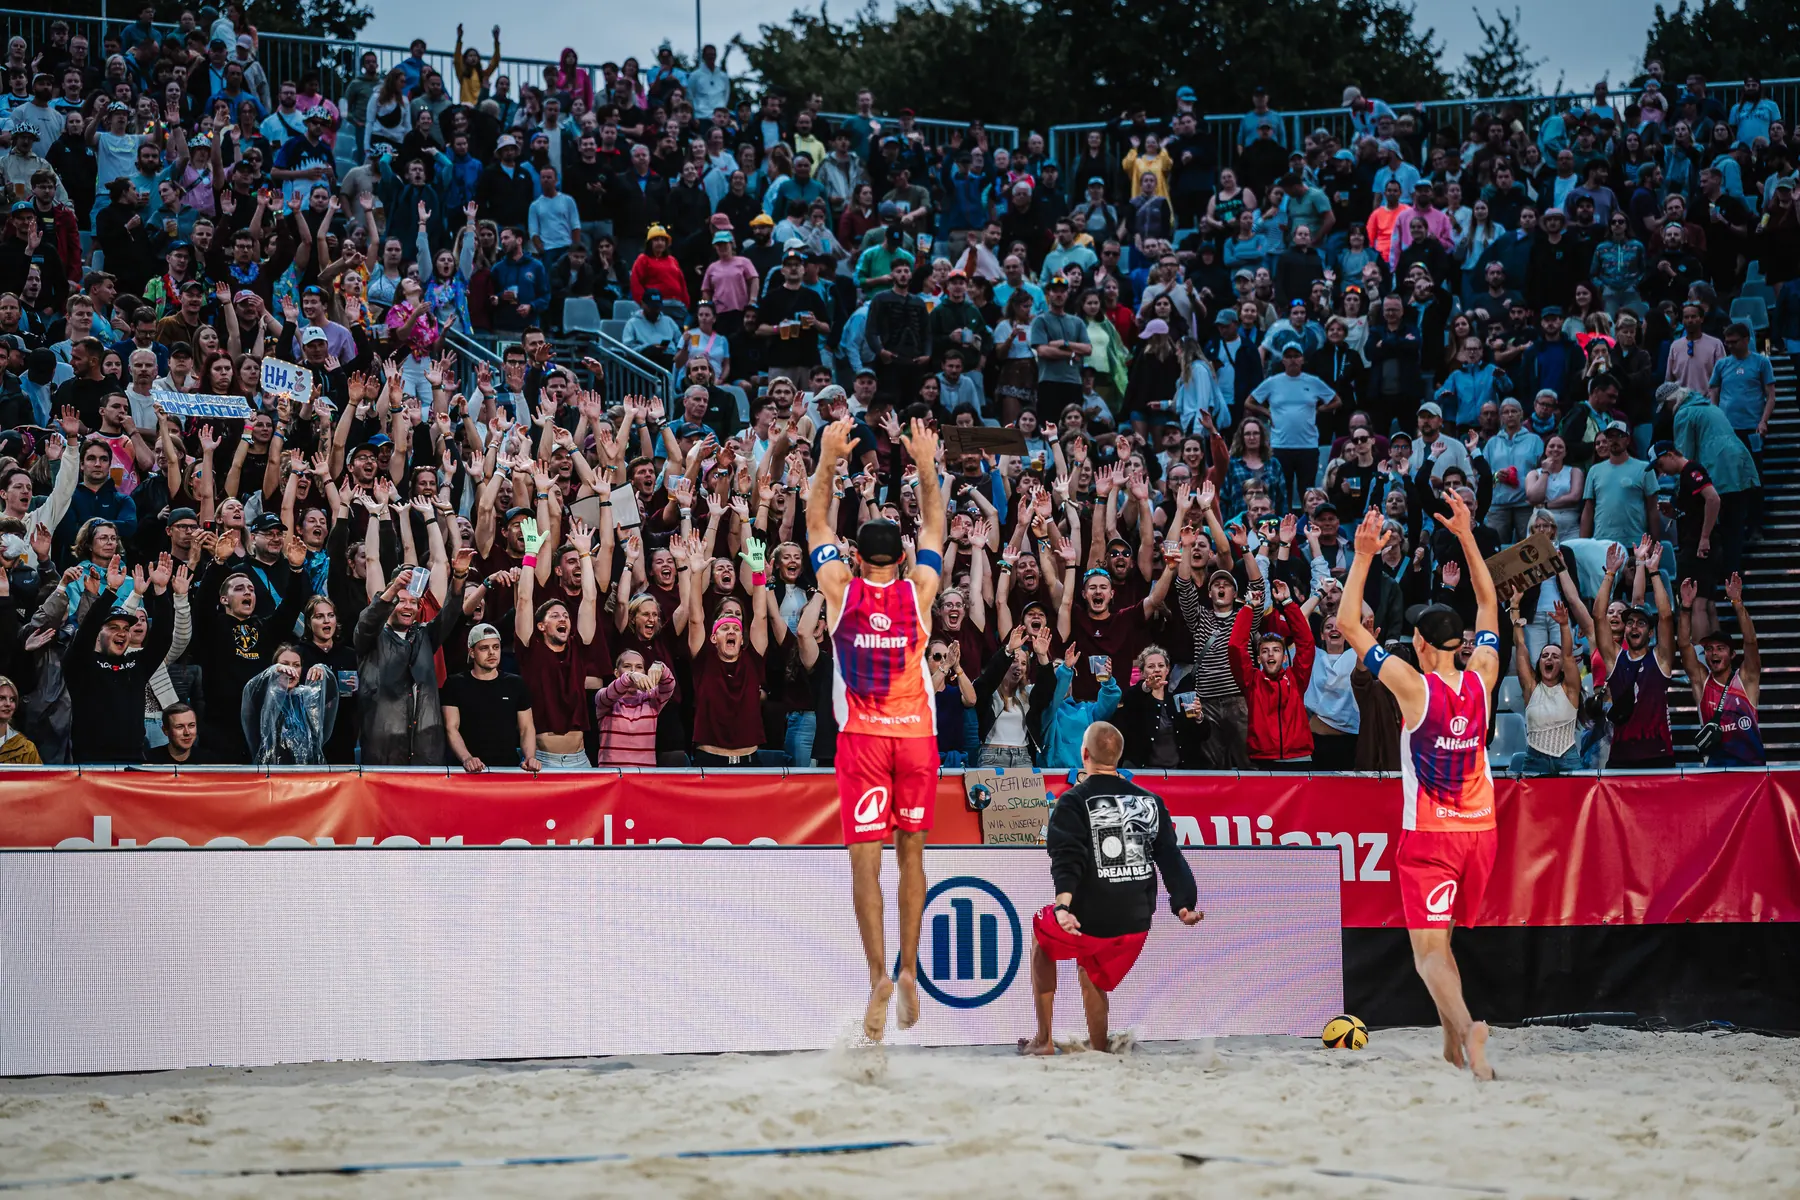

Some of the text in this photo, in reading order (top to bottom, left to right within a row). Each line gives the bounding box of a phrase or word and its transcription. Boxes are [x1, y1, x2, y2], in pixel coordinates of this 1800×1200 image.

[853, 633, 909, 649] Allianz
[1434, 735, 1480, 751] Allianz
[1097, 866, 1132, 878] DREAM
